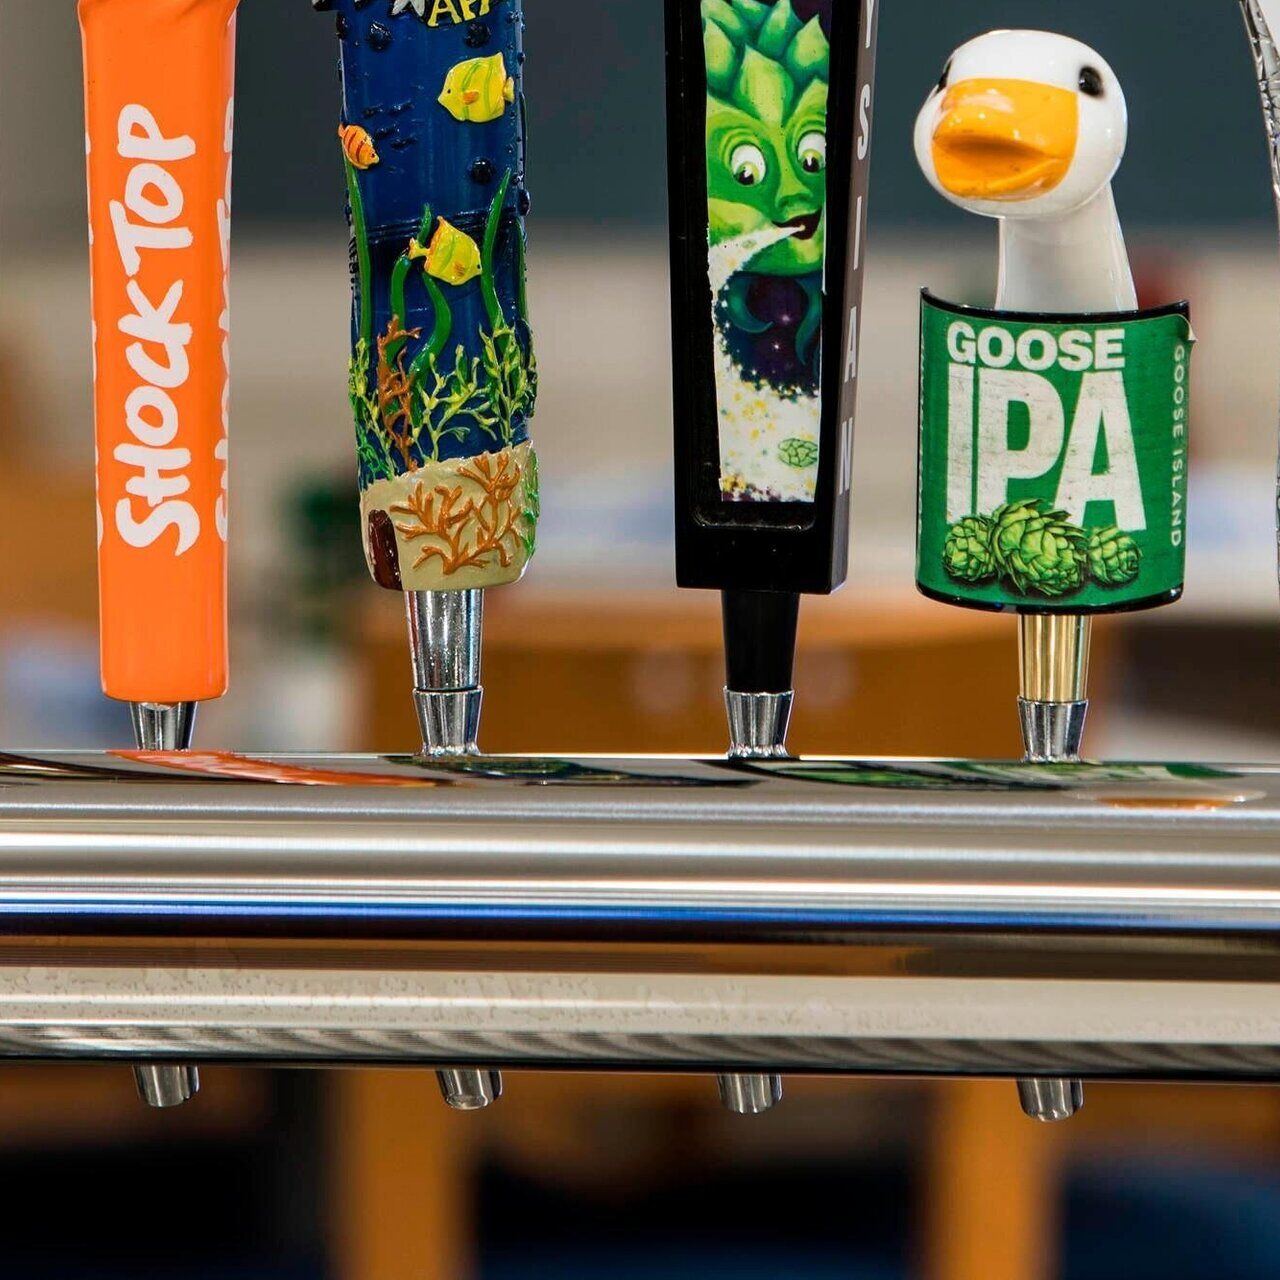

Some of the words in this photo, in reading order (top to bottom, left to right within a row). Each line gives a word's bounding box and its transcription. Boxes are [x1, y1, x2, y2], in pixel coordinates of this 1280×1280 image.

[109, 103, 196, 278] TOP
[946, 321, 1126, 371] GOOSE
[1172, 344, 1185, 437] GOOSE
[113, 279, 200, 556] SHOCK
[946, 362, 1147, 531] IPA
[1171, 449, 1184, 547] ISLAND
